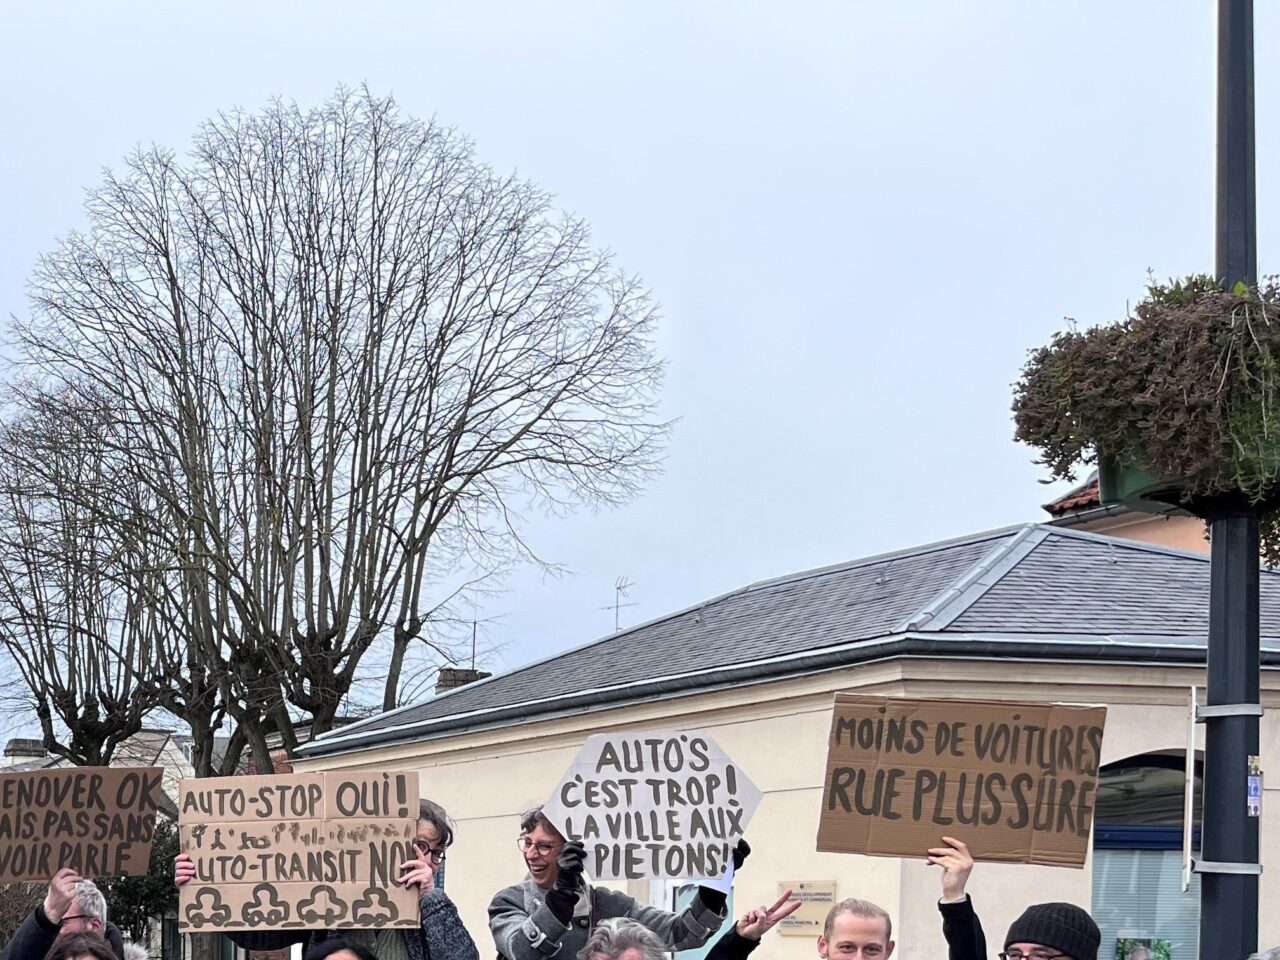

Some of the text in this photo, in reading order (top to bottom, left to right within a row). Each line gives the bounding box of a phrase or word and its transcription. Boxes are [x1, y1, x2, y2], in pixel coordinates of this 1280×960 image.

[595, 735, 710, 774] AUTO'S
[935, 721, 968, 757] DE
[116, 772, 162, 812] OK
[183, 783, 322, 818] AUTO-STOP
[560, 774, 638, 808] C'EST
[828, 766, 905, 820] RUE
[912, 768, 1006, 826] PLUS
[43, 809, 90, 838] PAS
[93, 812, 156, 843] SANS
[565, 806, 744, 842] LA VILLE AUX
[193, 850, 362, 884] UTO-TRANSIT
